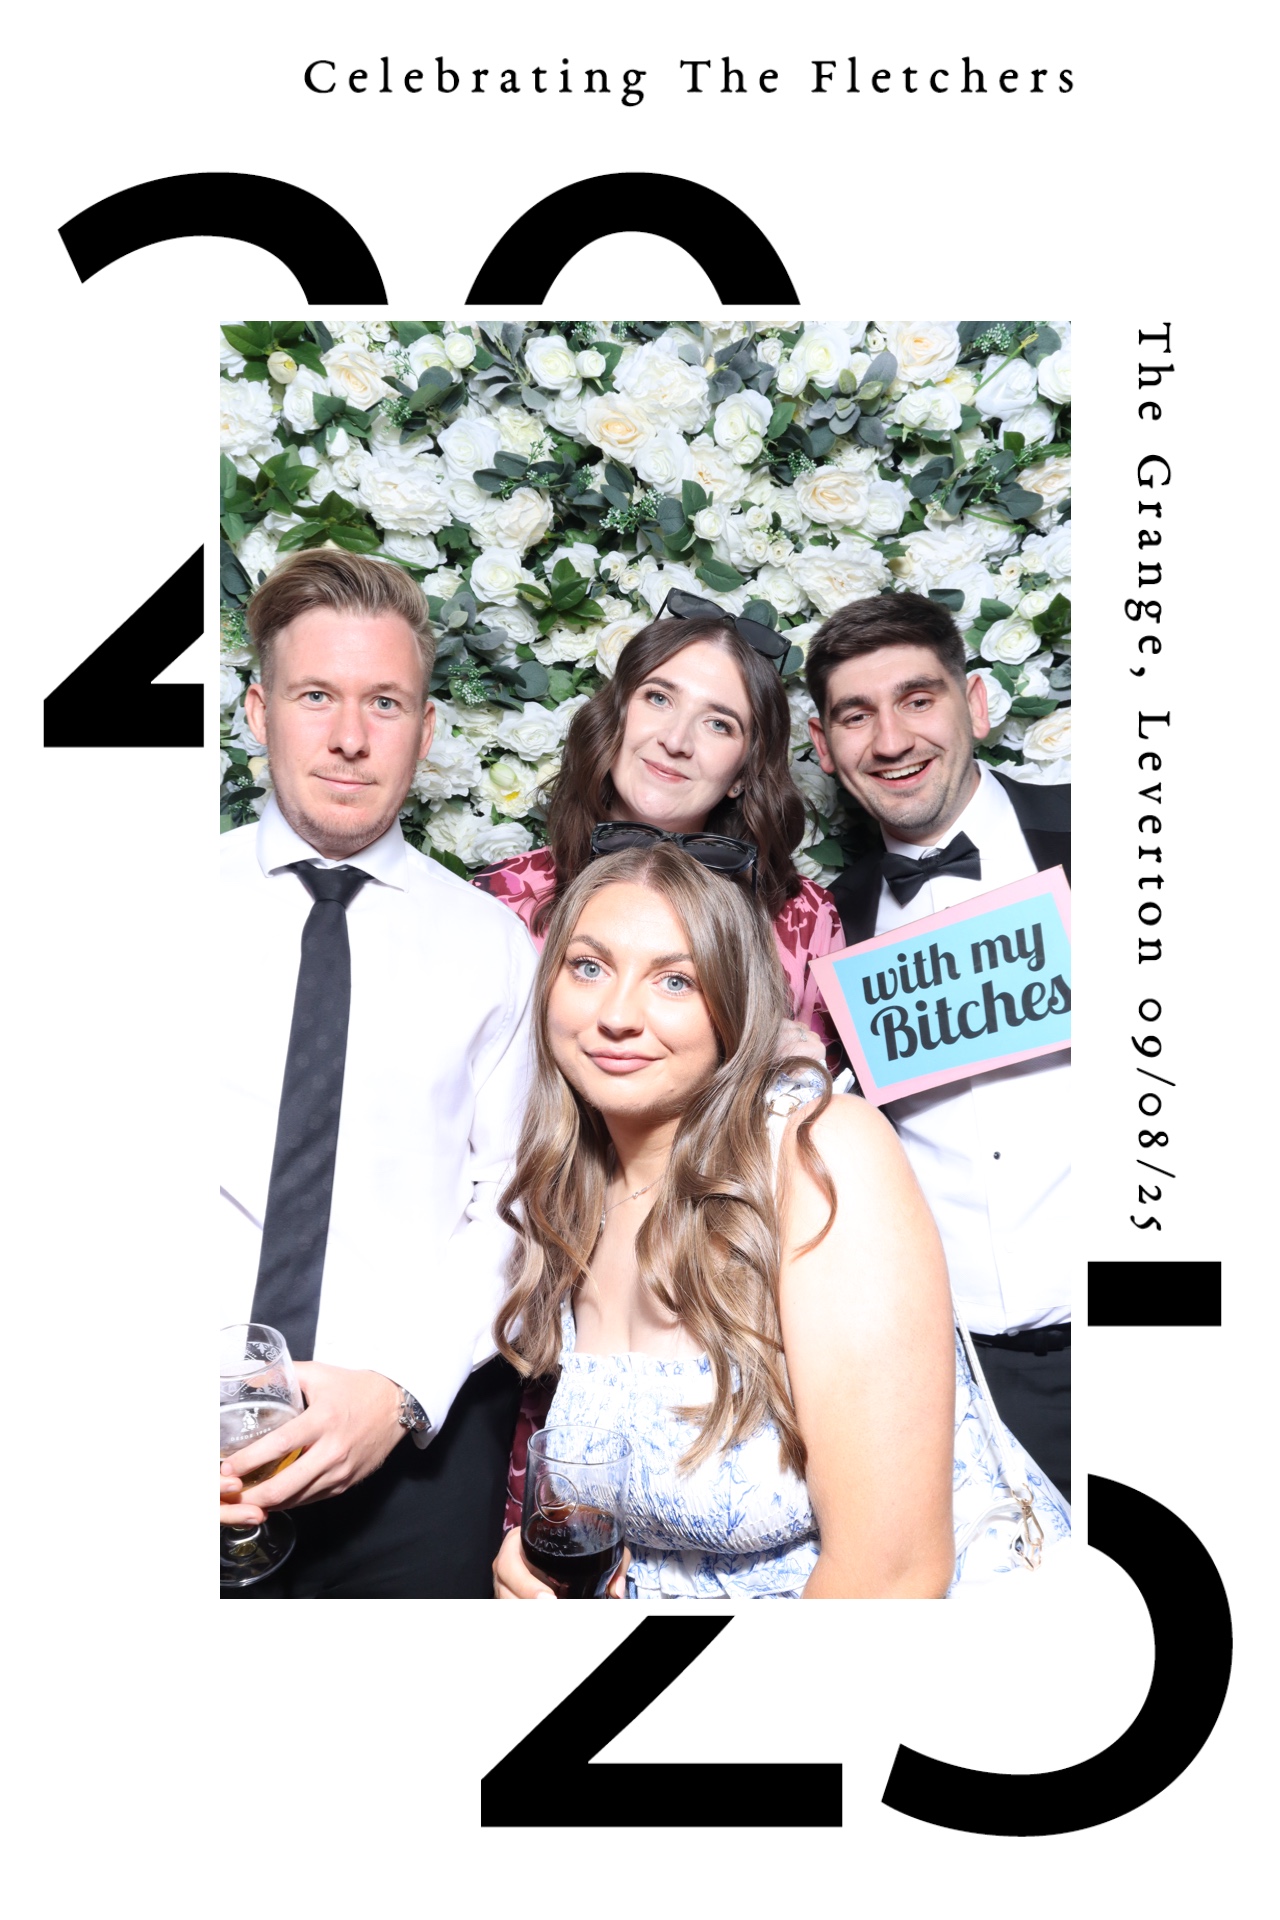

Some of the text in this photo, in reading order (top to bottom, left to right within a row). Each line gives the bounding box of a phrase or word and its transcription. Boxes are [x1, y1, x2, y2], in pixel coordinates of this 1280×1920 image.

[861, 922, 1046, 1005] with my
[869, 974, 1072, 1062] Bitches
